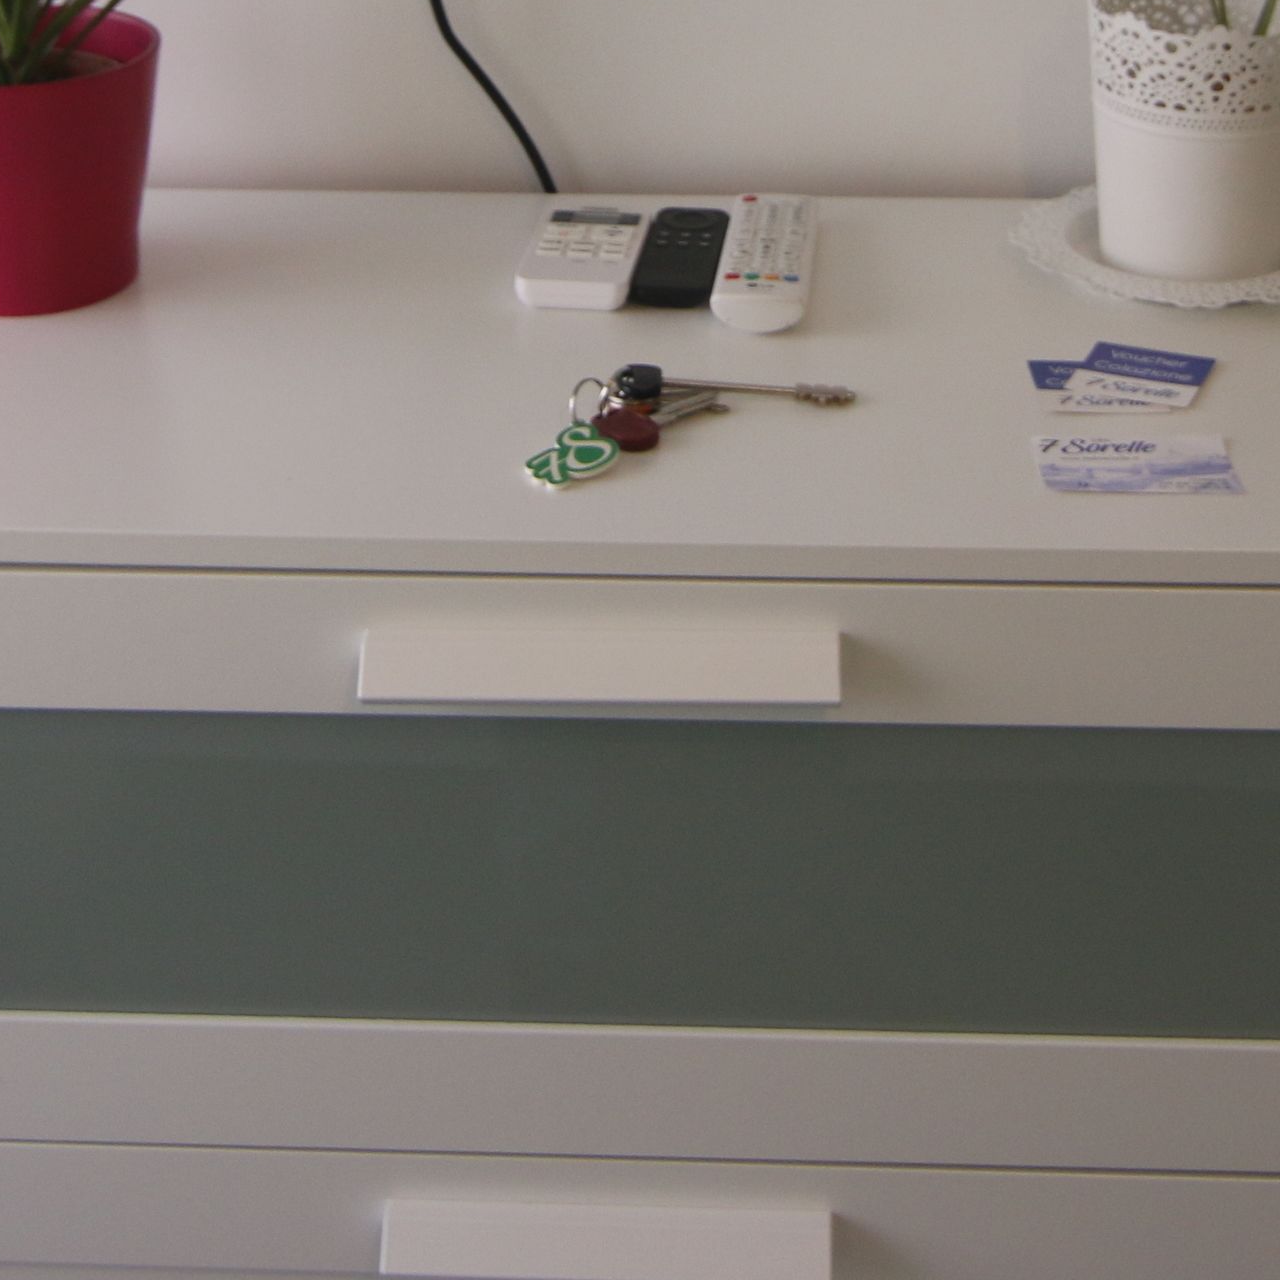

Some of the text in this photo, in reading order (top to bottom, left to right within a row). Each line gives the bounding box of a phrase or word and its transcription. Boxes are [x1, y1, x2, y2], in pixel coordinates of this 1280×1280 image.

[1111, 349, 1190, 368] Voucher
[1038, 438, 1157, 454] 7 Sorelle
